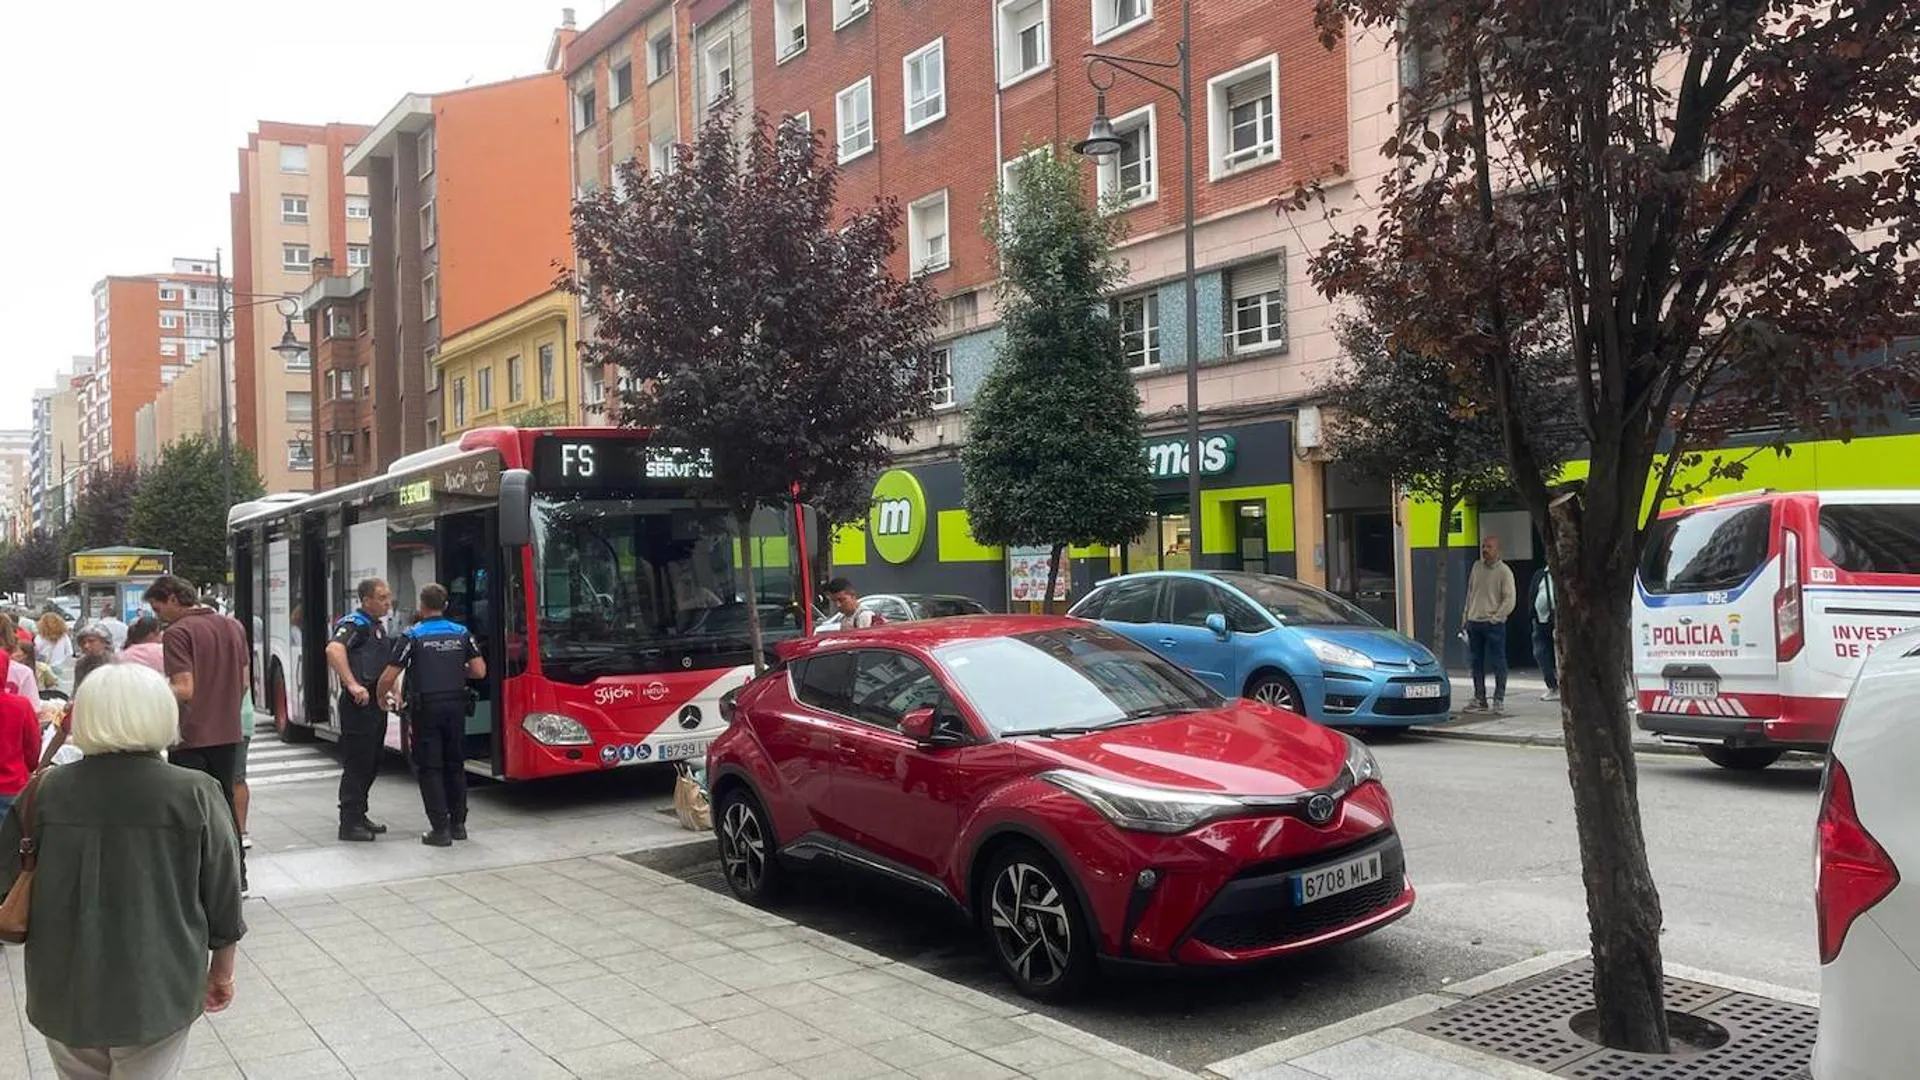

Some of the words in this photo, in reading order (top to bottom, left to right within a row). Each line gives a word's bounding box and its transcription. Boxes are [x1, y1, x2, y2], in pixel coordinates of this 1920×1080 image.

[562, 444, 594, 477] FS
[879, 499, 911, 535] m
[1707, 592, 1728, 604] 092
[1836, 643, 1859, 657] DE
[1675, 682, 1695, 697] 5911
[667, 743, 695, 757] 8799
[1305, 868, 1346, 897] 6708
[1350, 858, 1378, 884] MLW
